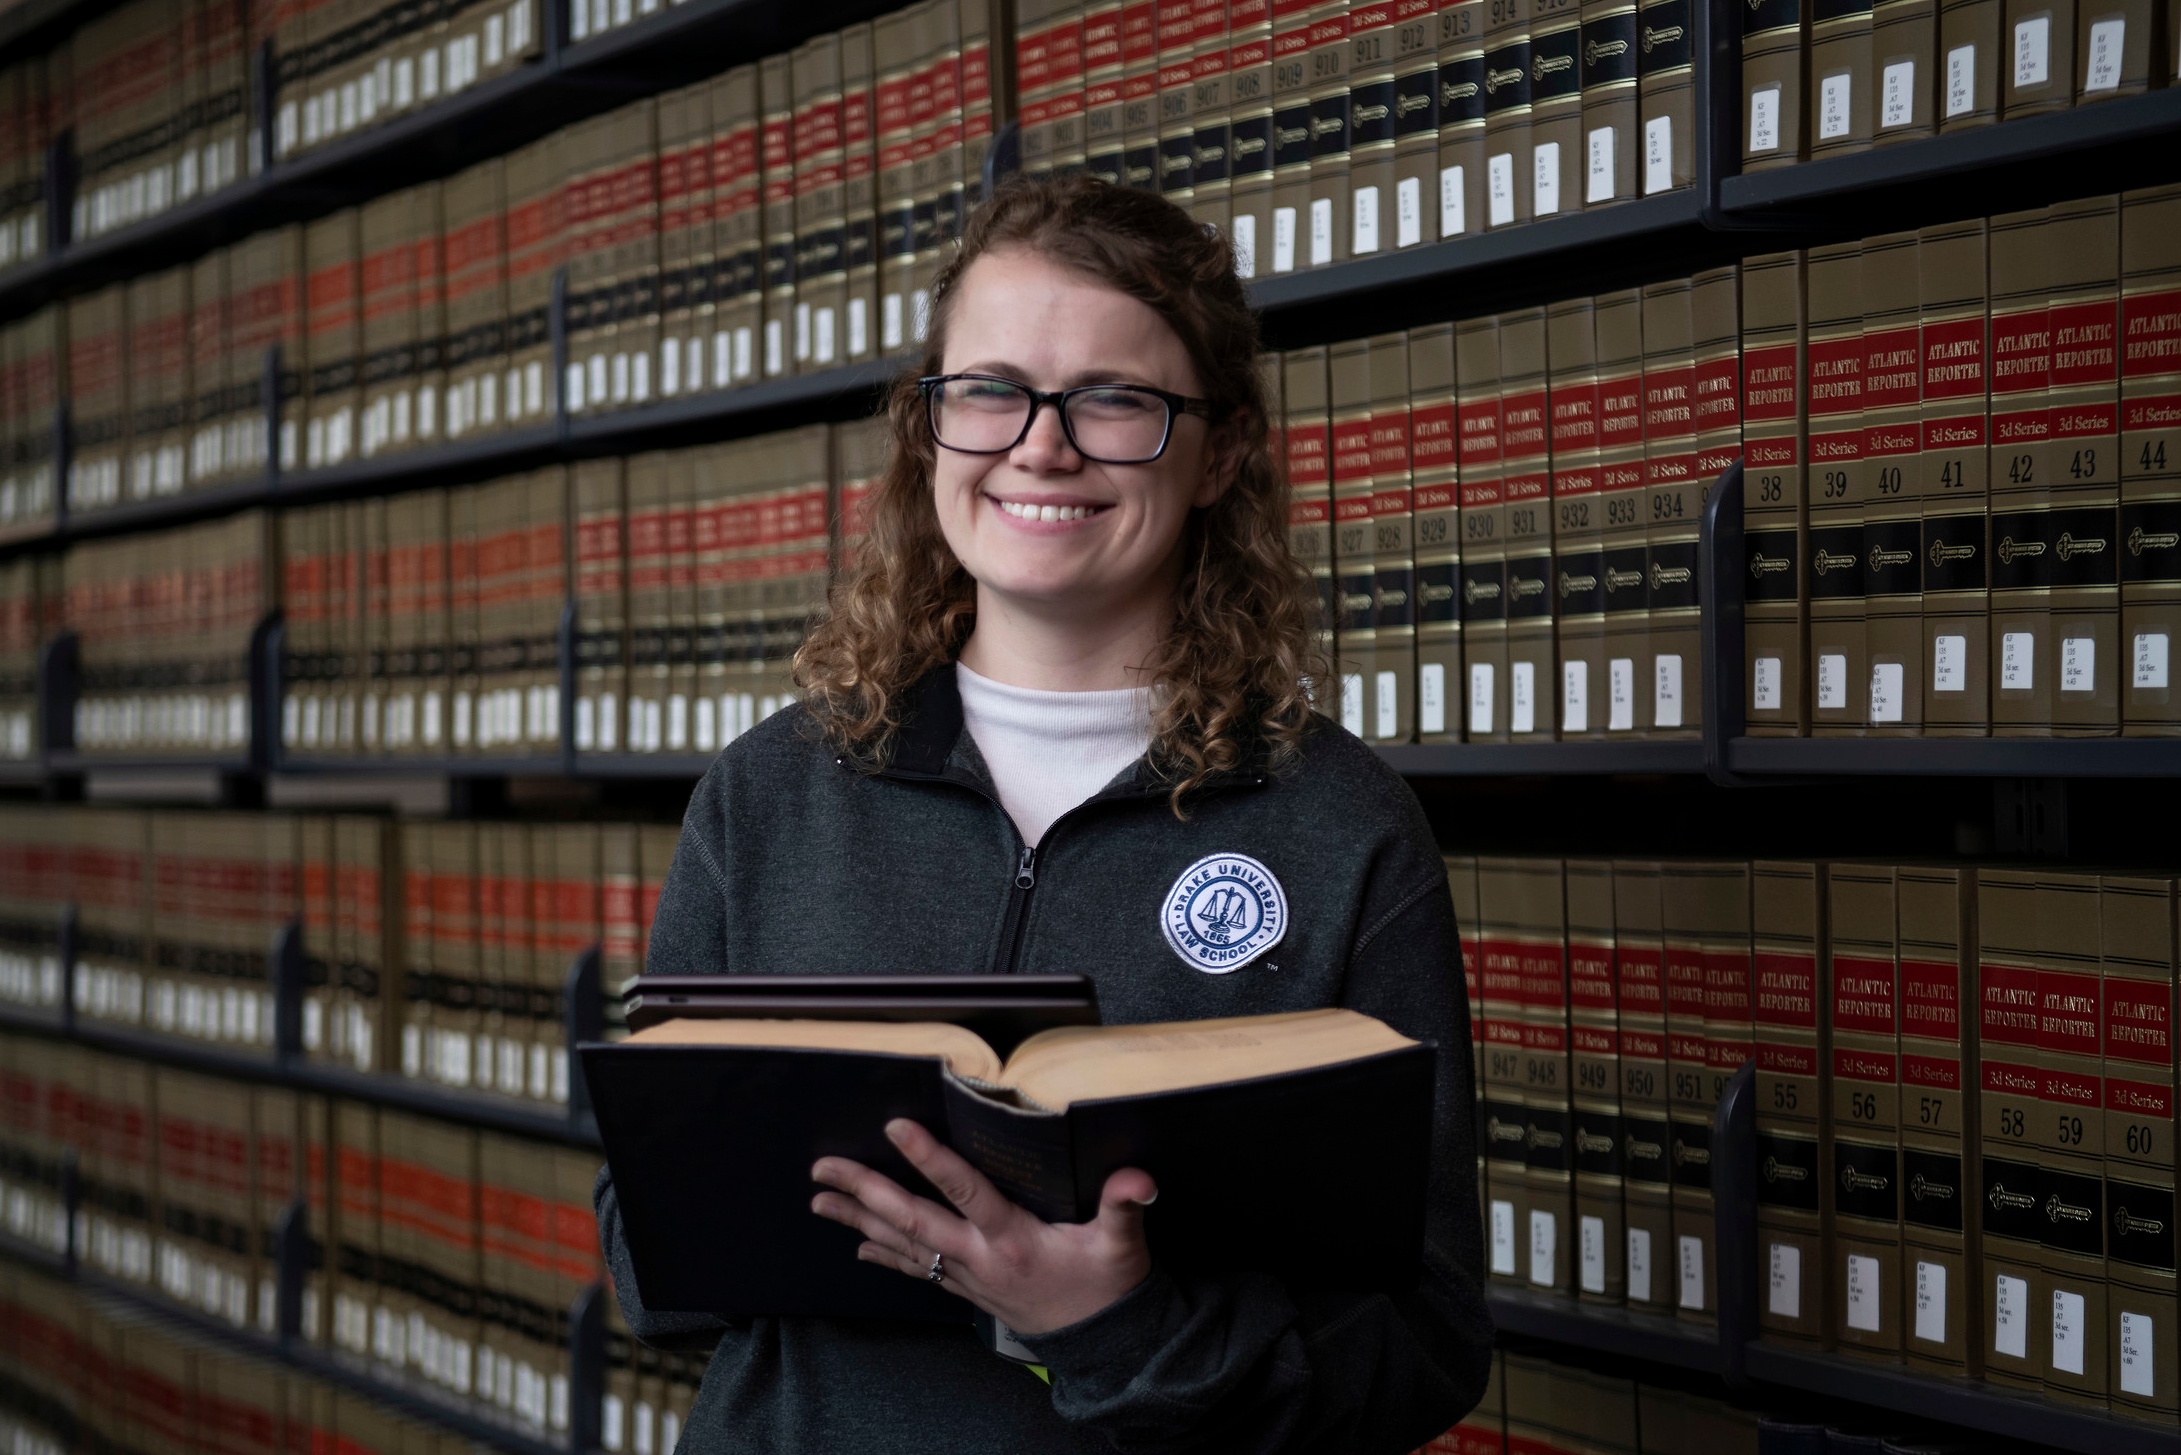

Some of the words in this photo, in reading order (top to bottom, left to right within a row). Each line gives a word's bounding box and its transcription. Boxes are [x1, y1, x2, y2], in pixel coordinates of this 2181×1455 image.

[1444, 10, 1470, 39] 913
[1356, 37, 1381, 63] 911
[1996, 332, 2050, 354] ATLANTIC
[2056, 323, 2112, 346] ATLANTIC
[1868, 349, 1916, 369] ATLANTIC
[1928, 339, 1980, 360] ATLANTIC
[2055, 348, 2112, 370] REPORTER
[2127, 338, 2181, 360] REPORTE
[1750, 366, 1793, 384] ATLANTIC
[1813, 358, 1860, 377] ATLANTIC
[1927, 362, 1980, 384] REPORTER
[1812, 380, 1861, 399] REPORTER
[1868, 372, 1916, 392] REPORTER
[1604, 394, 1638, 412] ATLANTIC
[1650, 386, 1688, 403] ATLANTIC
[1749, 388, 1794, 406] REPORTER
[1555, 401, 1592, 419] ATLANTIC
[1648, 406, 1690, 424] REPORTER
[2129, 408, 2144, 424] 3d
[2146, 406, 2181, 422] Series
[1554, 421, 1594, 439] REPORTER
[1603, 415, 1638, 432] REPORTER
[1999, 422, 2012, 438] 3d
[2014, 420, 2048, 436] Series
[2058, 416, 2072, 432] 3d
[2074, 414, 2109, 430] Series
[1870, 436, 1882, 450] 3d
[1884, 434, 1914, 449] Series
[1930, 428, 1943, 444] 3d
[1944, 426, 1978, 442] Series
[1752, 448, 1762, 462] 3d
[1764, 447, 1791, 460] Series
[1815, 444, 1826, 457] 3d
[1829, 442, 1858, 455] Series
[2140, 441, 2166, 470] 44
[1661, 463, 1688, 476] Series
[2010, 454, 2032, 483] 42
[2070, 450, 2095, 478] 43
[1878, 468, 1900, 494] 40
[1941, 461, 1964, 488] 41
[1761, 476, 1782, 502] 38
[1825, 472, 1846, 498] 39
[1562, 502, 1588, 528] 932
[1609, 498, 1635, 524] 933
[1654, 494, 1683, 519] 934
[1422, 518, 1446, 542] 929
[1468, 514, 1494, 538] 930
[1514, 510, 1536, 534] 931
[1174, 870, 1211, 912] DRAKE
[1218, 864, 1276, 934] UNIVERSITY
[1175, 922, 1199, 949] LAW
[1199, 940, 1257, 962] SCHOOL
[1204, 930, 1230, 944] 1865
[1706, 970, 1746, 986] ATLANTIC
[1760, 972, 1810, 991] ATLANTIC
[1840, 978, 1890, 996] ATLANTIC
[1906, 982, 1955, 1000] ATLANTIC
[1985, 986, 2036, 1006] ATLANTIC
[1760, 993, 1810, 1013] REPORTER
[1838, 999, 1891, 1018] REPORTER
[2043, 993, 2094, 1014] ATLANTIC
[2112, 1000, 2166, 1022] ATLANTIC
[1906, 1004, 1956, 1024] REPORTER
[1984, 1008, 2037, 1030] REPORTER
[2042, 1016, 2095, 1038] REPORTER
[2111, 1024, 2167, 1047] REPORTER
[1762, 1051, 1774, 1066] 3d
[1777, 1052, 1808, 1070] Series
[1841, 1058, 1854, 1072] 3d
[1856, 1060, 1889, 1076] Series
[1580, 1062, 1606, 1088] 949
[1628, 1070, 1653, 1096] 950
[1910, 1064, 1921, 1078] 3d
[1924, 1066, 1954, 1082] Series
[1990, 1071, 2002, 1086] 3d
[2005, 1072, 2036, 1090] Series
[1676, 1072, 1702, 1099] 951
[2046, 1080, 2059, 1095] 3d
[2061, 1082, 2093, 1100] Series
[1774, 1083, 1797, 1110] 55
[1852, 1092, 1876, 1120] 56
[2114, 1090, 2127, 1105] 3d
[2130, 1092, 2164, 1110] Series
[1920, 1098, 1942, 1125] 57
[2001, 1108, 2024, 1137] 58
[2059, 1116, 2082, 1145] 59
[2126, 1125, 2152, 1154] 60
[2056, 1302, 2064, 1310] 135
[2122, 1316, 2130, 1324] KF
[2122, 1326, 2130, 1334] 135
